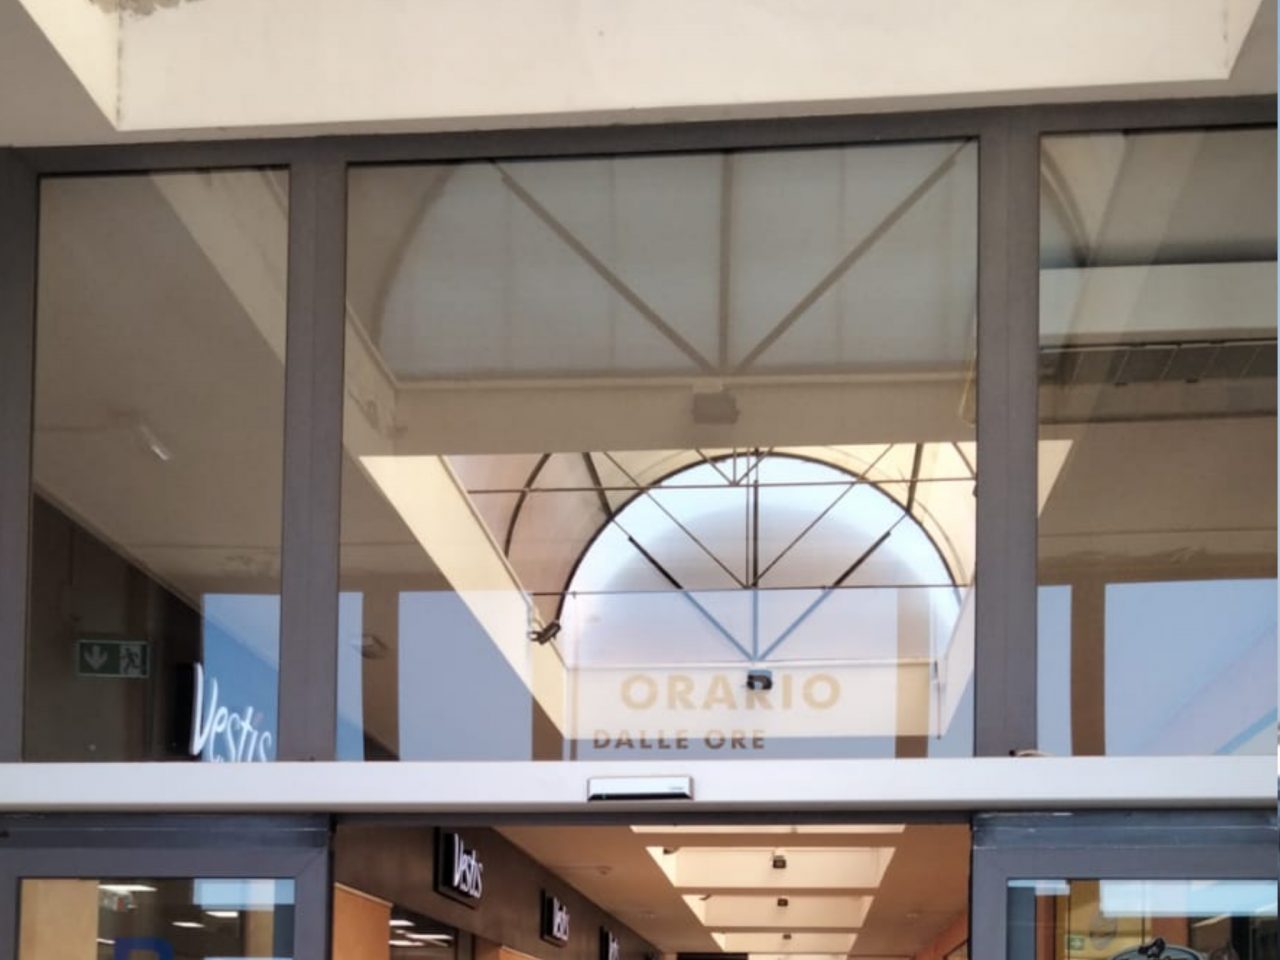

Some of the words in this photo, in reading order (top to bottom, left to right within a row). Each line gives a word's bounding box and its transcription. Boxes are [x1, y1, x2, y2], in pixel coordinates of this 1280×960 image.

[191, 661, 273, 762] Vestis
[620, 673, 841, 711] ORARIO
[593, 729, 689, 750] DALLE
[704, 729, 766, 750] ORE
[453, 832, 483, 898] Vestis
